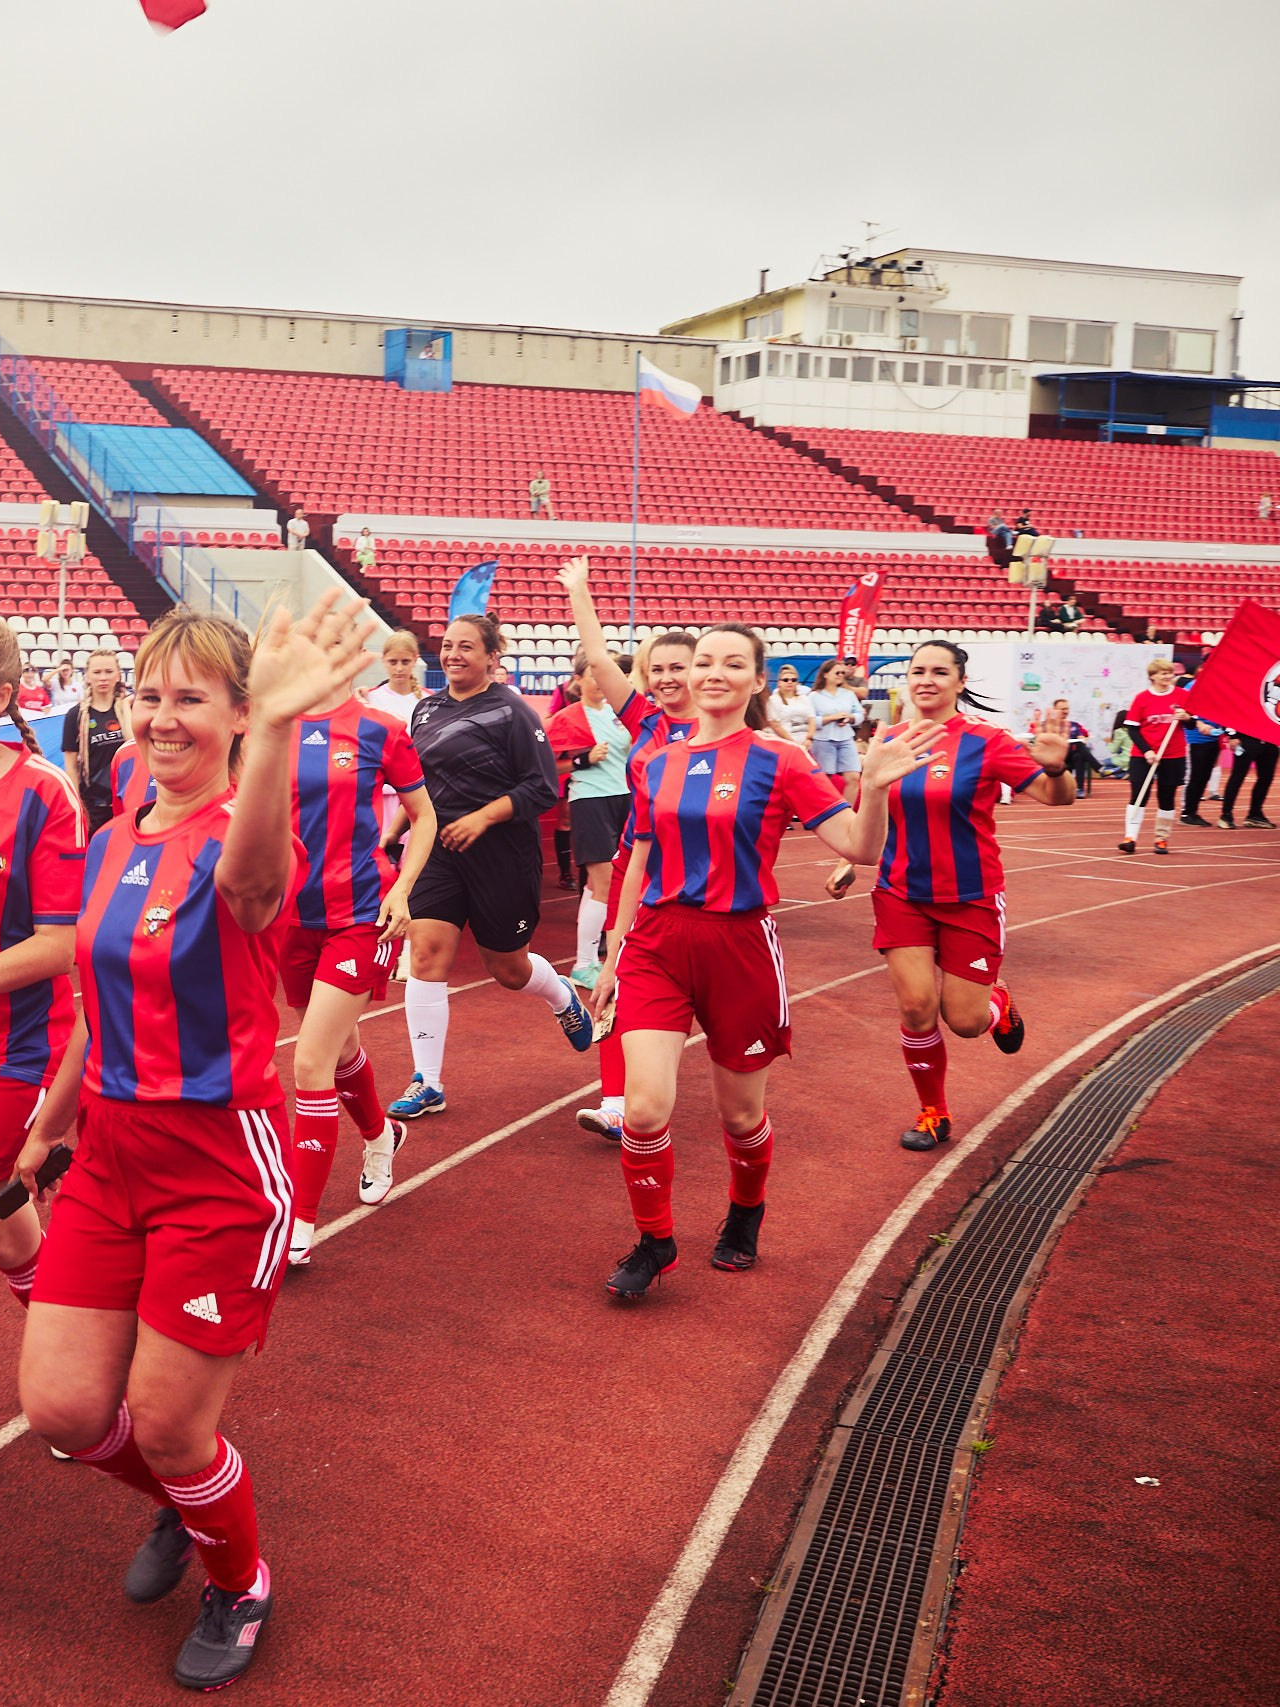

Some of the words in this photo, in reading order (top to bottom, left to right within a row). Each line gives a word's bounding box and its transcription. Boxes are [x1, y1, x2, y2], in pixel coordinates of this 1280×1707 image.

[121, 874, 150, 886] adidas
[335, 963, 358, 977] adidas
[182, 1302, 222, 1325] adidas
